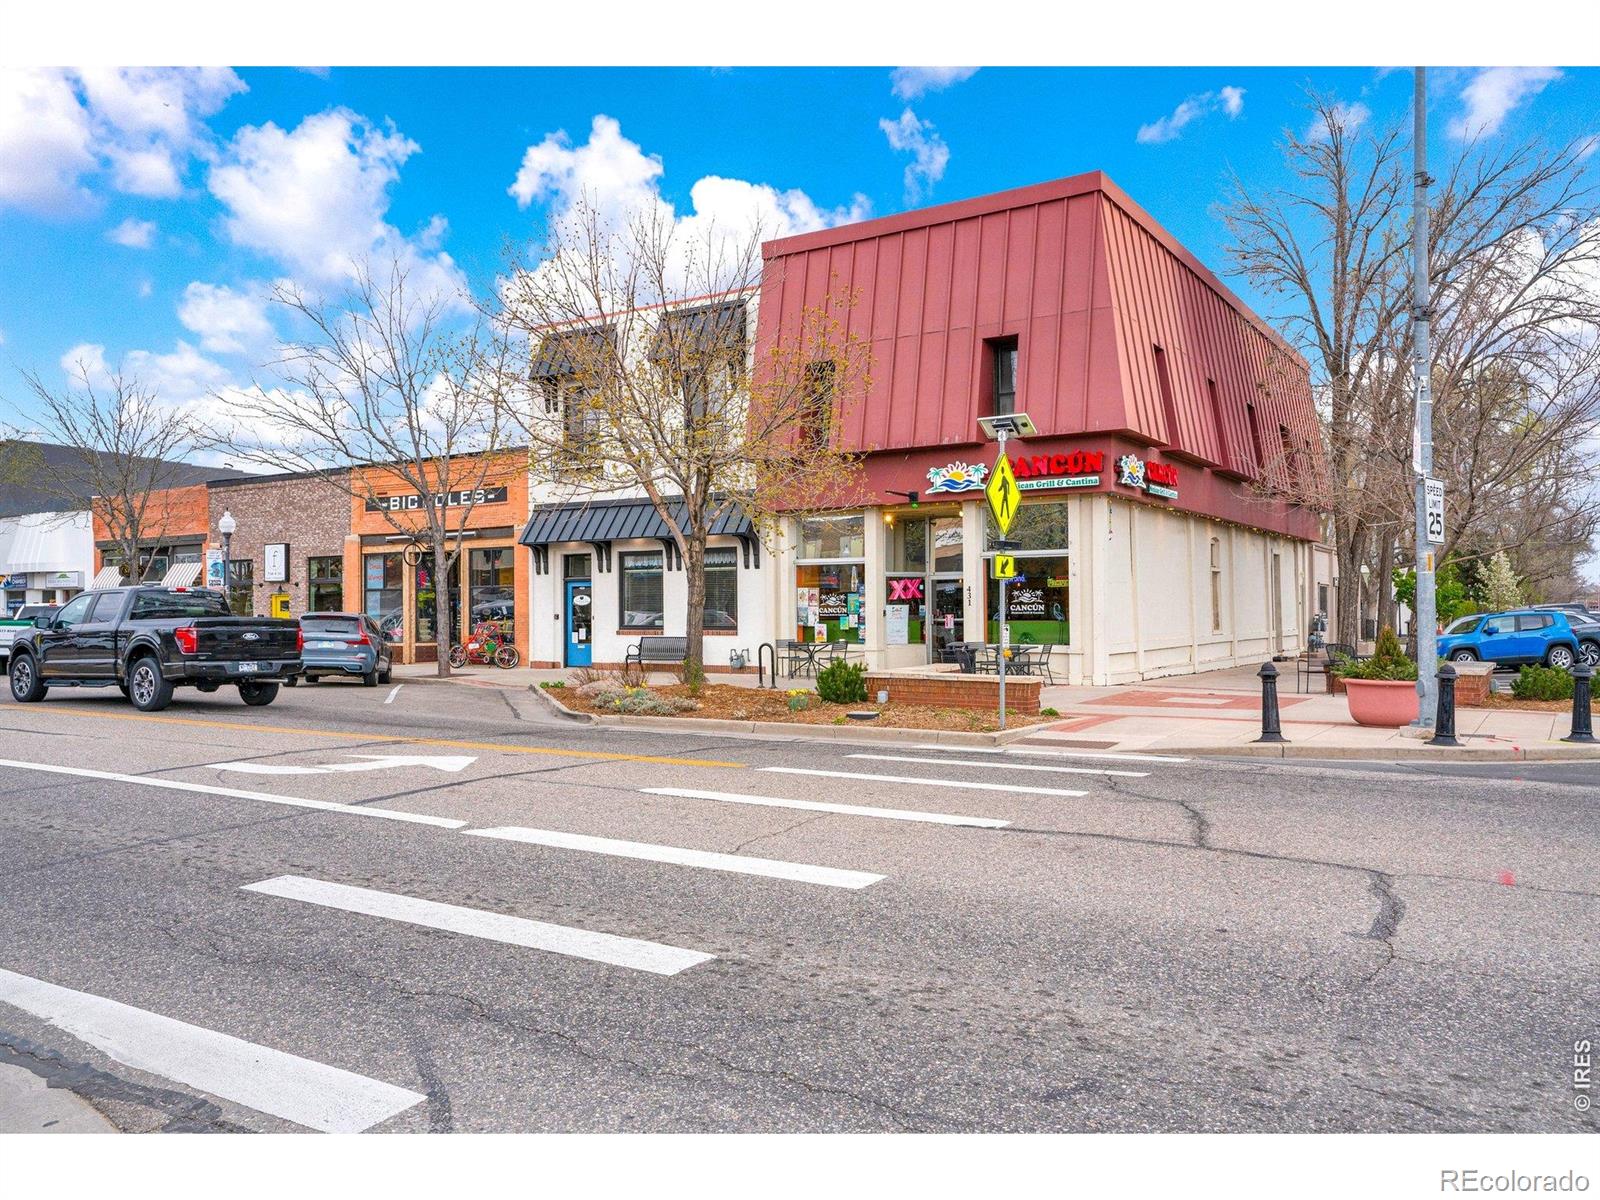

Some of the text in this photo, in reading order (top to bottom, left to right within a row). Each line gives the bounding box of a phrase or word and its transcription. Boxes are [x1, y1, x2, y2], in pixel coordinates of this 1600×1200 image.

[1036, 480, 1055, 488] Grill
[1056, 479, 1065, 487] &
[1066, 477, 1098, 486] Cantina
[1427, 485, 1442, 497] SPEED
[390, 489, 485, 511] BICCLES
[1429, 498, 1441, 510] LIMIT
[1429, 511, 1443, 536] 25
[888, 578, 924, 600] XX
[819, 606, 848, 614] CANCÚN
[1010, 603, 1045, 611] CANCÚN
